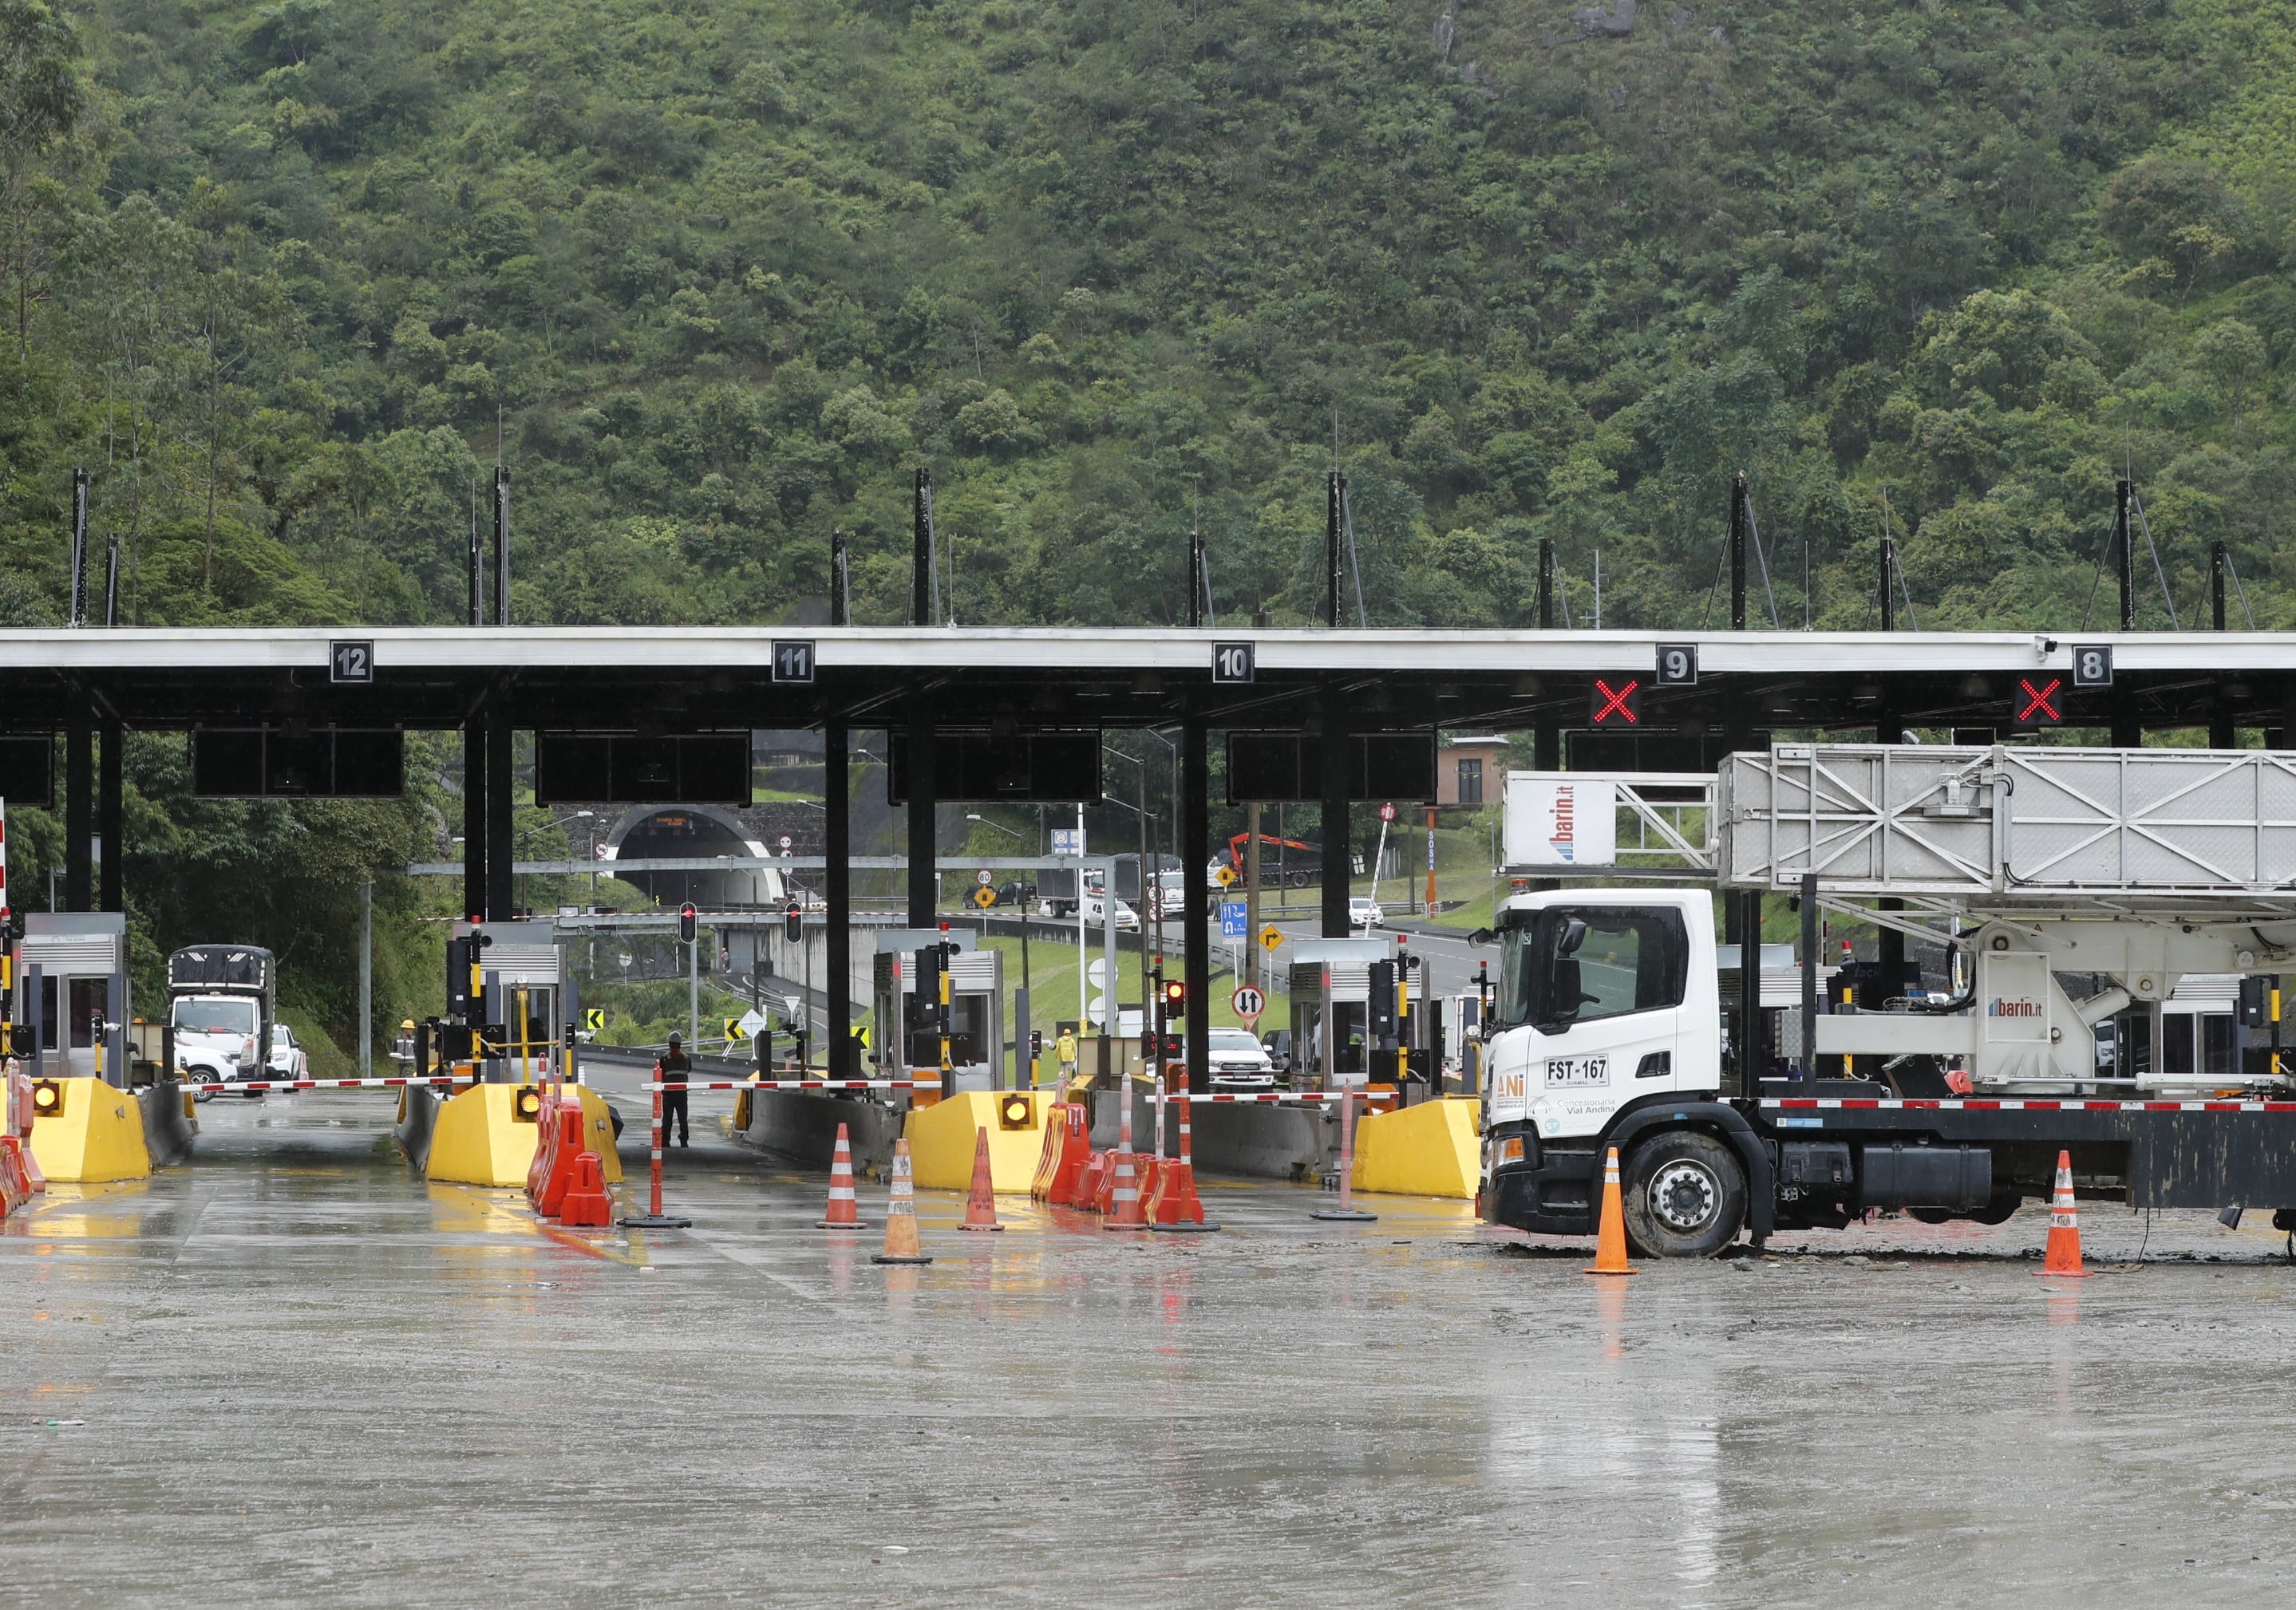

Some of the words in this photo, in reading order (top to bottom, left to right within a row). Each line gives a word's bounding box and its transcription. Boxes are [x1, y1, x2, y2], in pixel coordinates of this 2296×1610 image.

[338, 648, 366, 676] 12
[781, 648, 805, 676] 11
[1219, 649, 1247, 677] 10
[1666, 650, 1688, 679] 9
[2083, 651, 2104, 679] 8
[1549, 786, 1574, 842] barin.it
[979, 873, 990, 882] 80
[1998, 997, 2043, 1017] barin.it
[1557, 1098, 1615, 1107] Concesionaria
